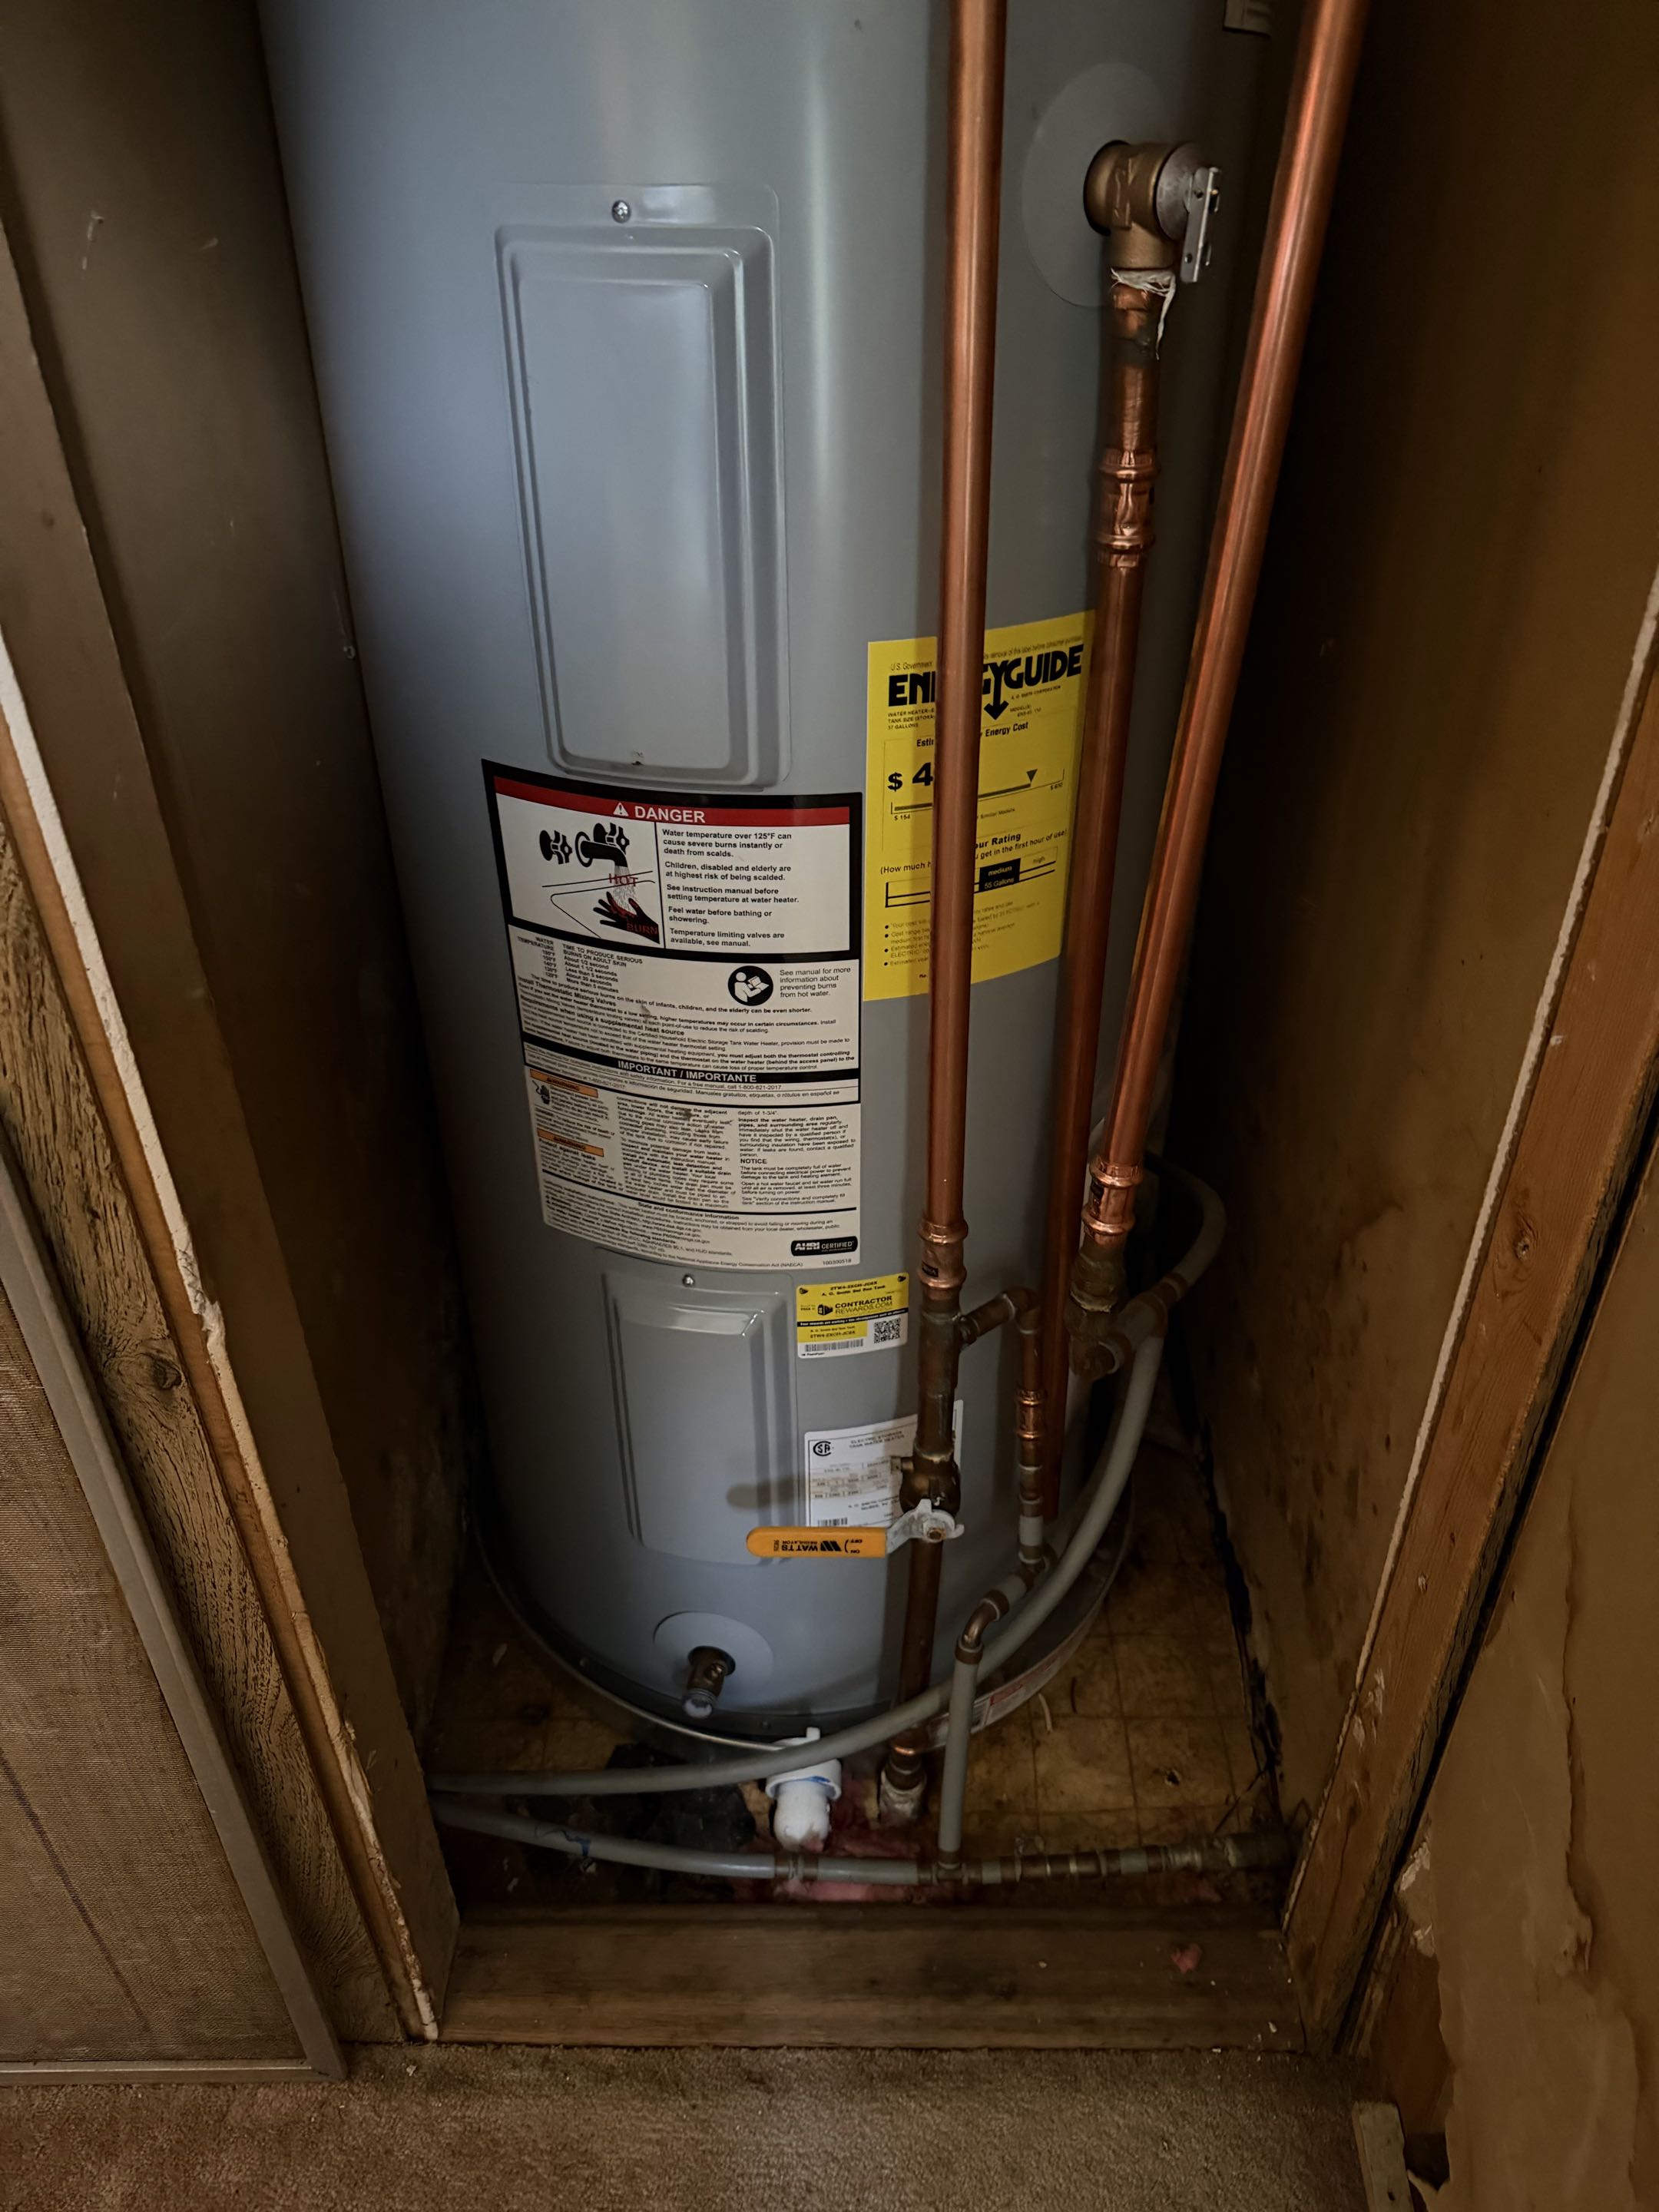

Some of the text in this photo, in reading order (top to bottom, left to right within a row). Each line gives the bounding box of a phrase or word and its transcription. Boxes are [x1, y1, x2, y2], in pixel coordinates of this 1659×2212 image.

[889, 644, 1084, 707] ENYGUIDE
[985, 722, 1028, 737] Energy Cost
[888, 773, 902, 792] $
[634, 806, 706, 823] DANGER
[663, 829, 684, 837] Water
[687, 830, 732, 839] temperature
[975, 833, 1021, 849] our Rating
[1015, 842, 1028, 850] first
[1030, 838, 1045, 847] hour
[665, 862, 699, 870] Children,
[881, 866, 901, 874] (How
[988, 866, 1012, 876] medium
[609, 873, 638, 887] HOT
[675, 872, 702, 881] highest
[730, 873, 751, 882] being
[994, 877, 1015, 887] Gallons
[667, 893, 692, 902] setting
[694, 895, 740, 903] temperature
[669, 916, 709, 925] showering.
[670, 928, 715, 937] Temperature
[717, 931, 745, 939] limiting
[563, 949, 582, 958] BURNS
[587, 949, 614, 959] PRODUCE
[617, 955, 643, 964] SERIOUS
[618, 1061, 677, 1078] IMPORTANT
[686, 1071, 757, 1082] IMPORTANTE
[795, 1241, 853, 1251] AHRI CERTIFIED
[836, 1296, 892, 1308] CONTRACTOR
[836, 1301, 892, 1313] REWARDS.COM
